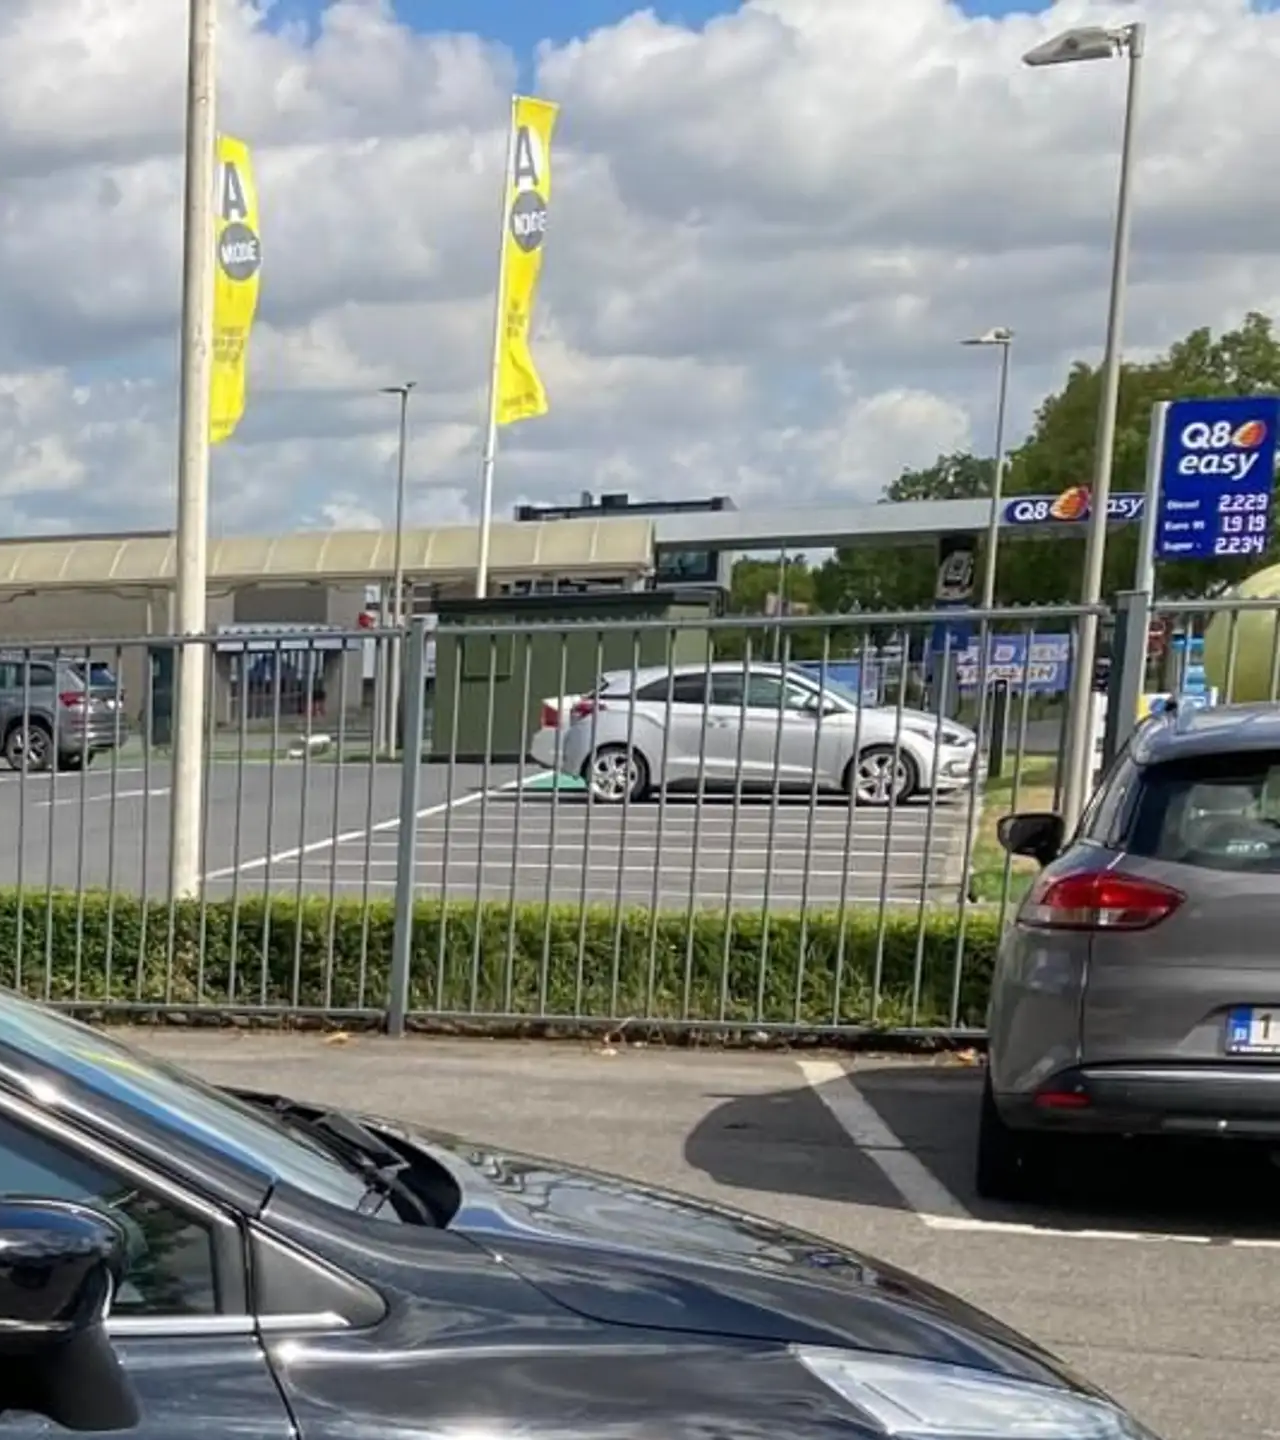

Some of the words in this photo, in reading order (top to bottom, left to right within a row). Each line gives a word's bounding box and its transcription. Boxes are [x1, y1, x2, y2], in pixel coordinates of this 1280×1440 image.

[515, 126, 539, 187] A
[222, 161, 248, 219] A
[1181, 421, 1231, 449] Q8
[1178, 452, 1259, 480] easy
[1014, 501, 1049, 520] Q8
[1087, 497, 1147, 518] asy
